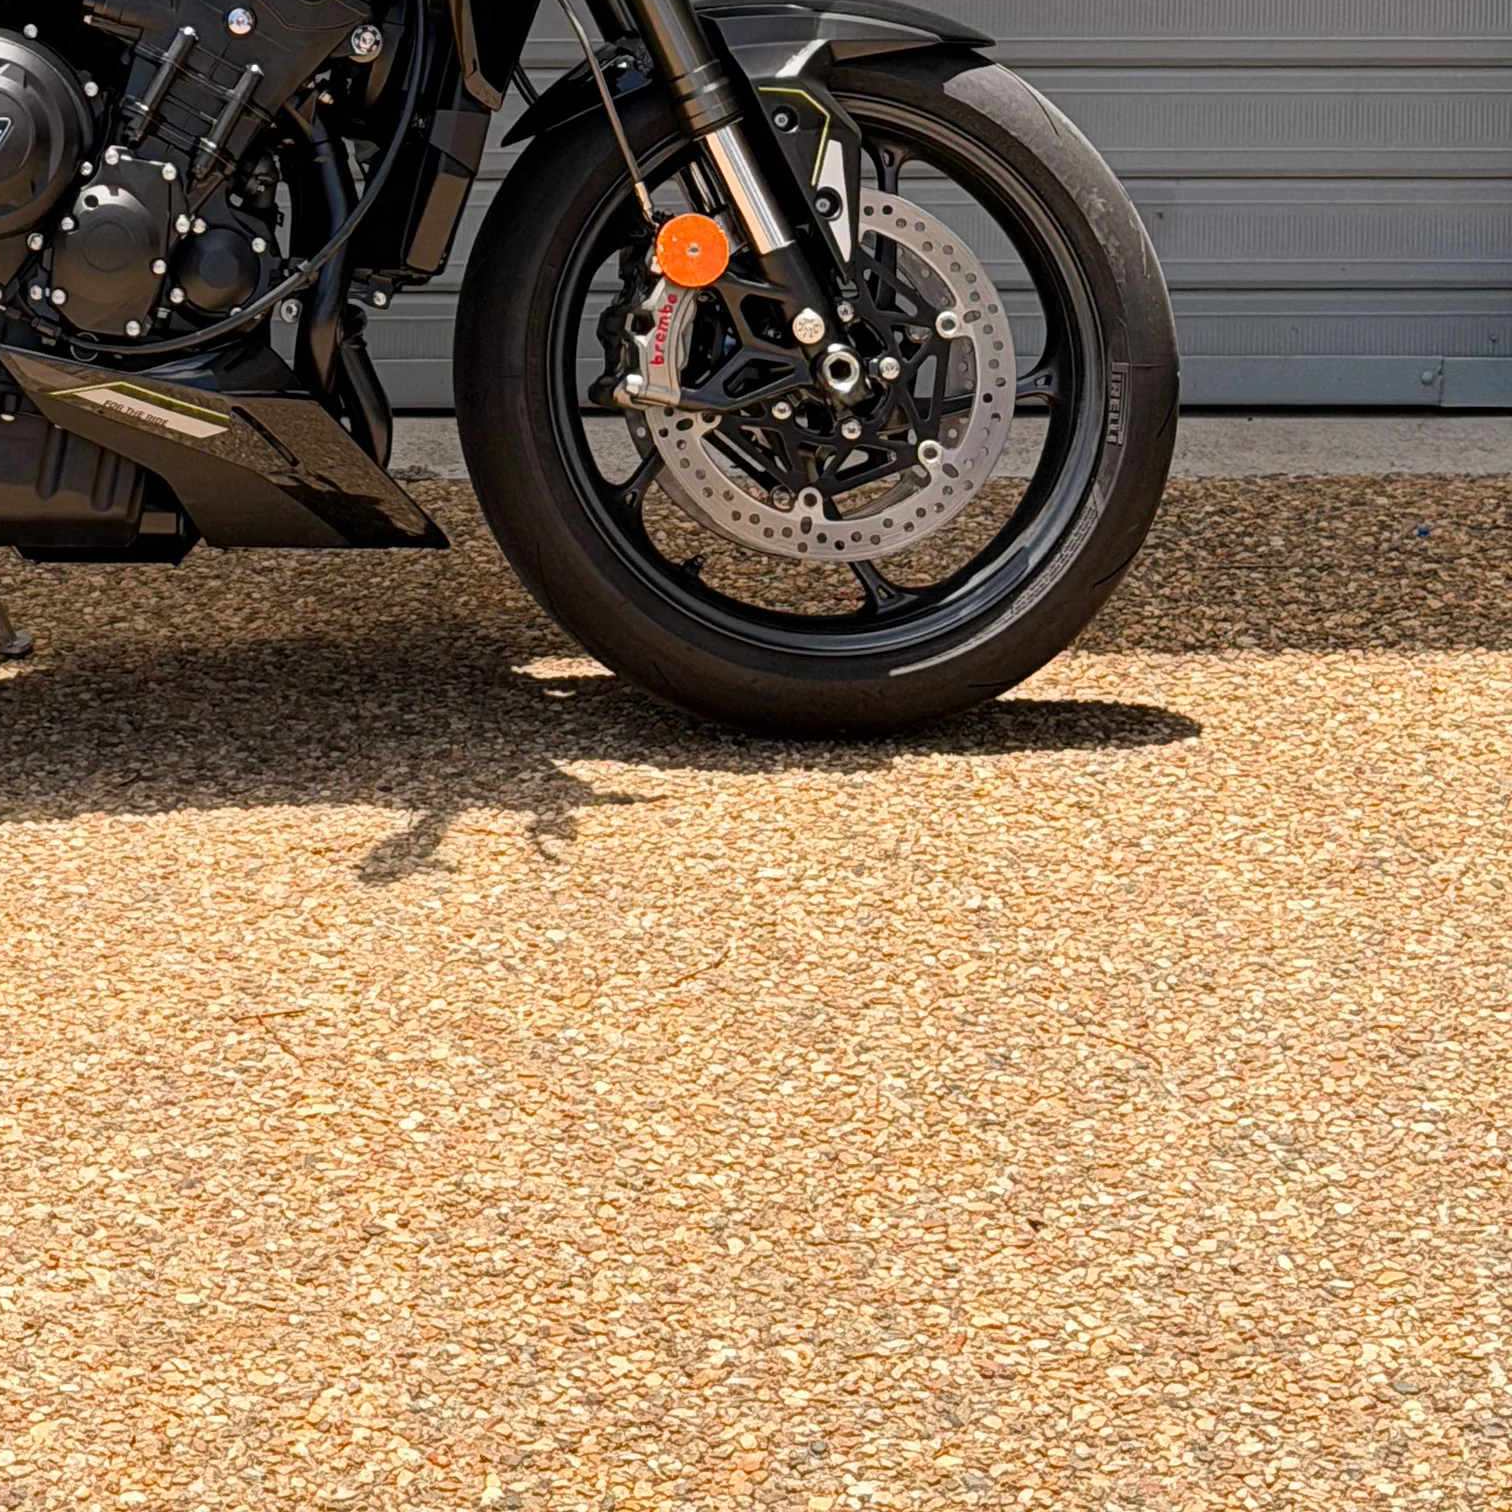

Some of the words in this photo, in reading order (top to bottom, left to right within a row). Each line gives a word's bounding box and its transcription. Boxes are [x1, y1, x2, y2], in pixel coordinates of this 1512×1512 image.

[650, 293, 678, 366] brembo
[103, 399, 124, 412] FOR
[126, 406, 143, 419] THE
[146, 414, 169, 426] RIDE
[1106, 361, 1130, 445] PIRELLI
